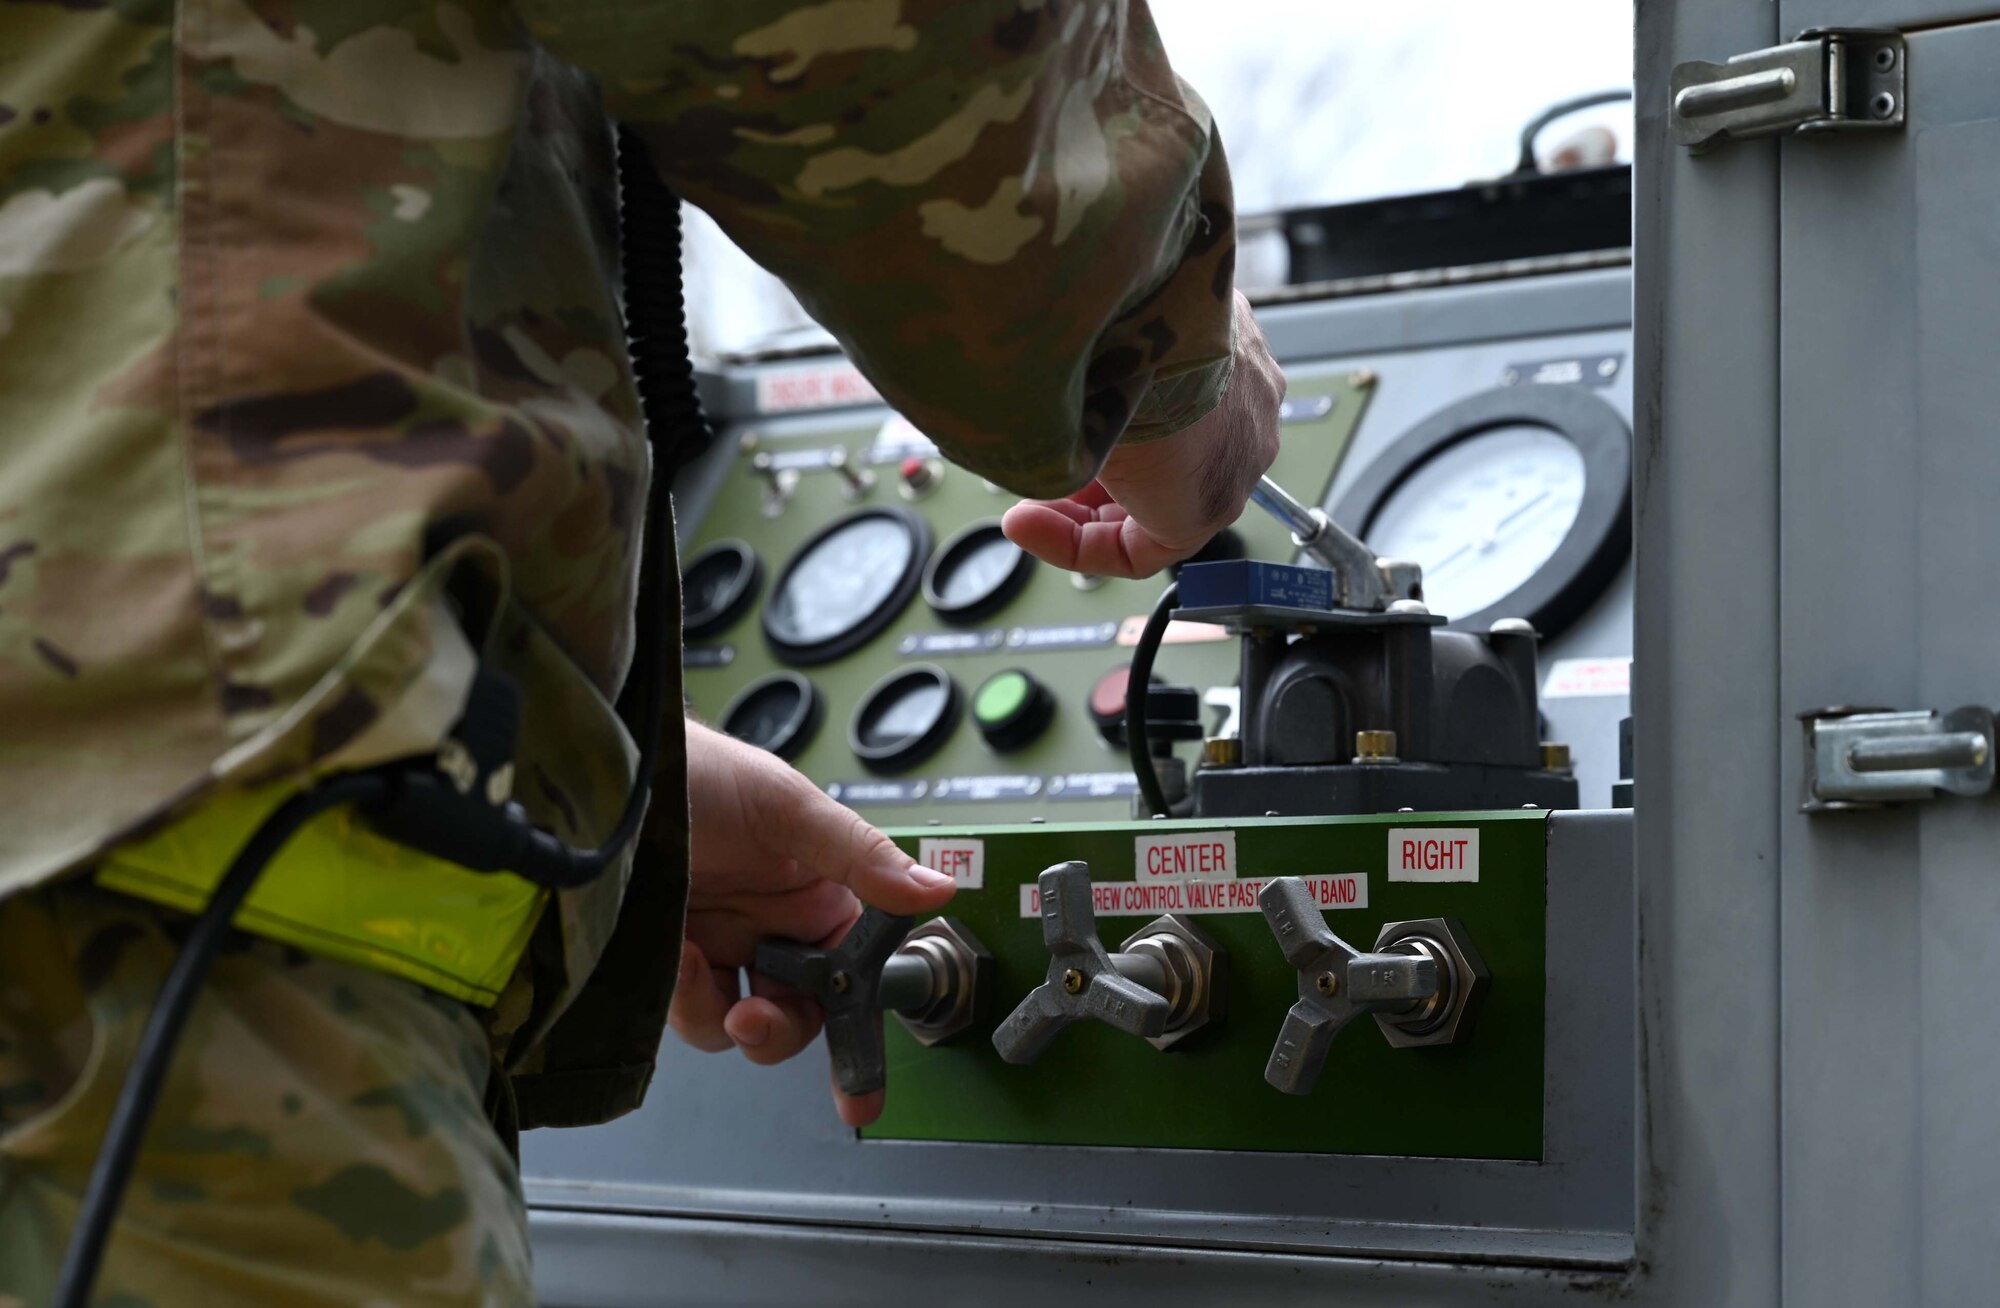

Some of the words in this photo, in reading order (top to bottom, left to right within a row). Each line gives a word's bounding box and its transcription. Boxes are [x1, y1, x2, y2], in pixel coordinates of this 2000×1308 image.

[1147, 843, 1226, 875] CENTER
[1402, 840, 1468, 871] RIGHT
[1124, 884, 1183, 911] CONTROL
[1186, 884, 1224, 908] VALVE
[1228, 882, 1262, 908] PAST
[1321, 879, 1356, 904] BAND
